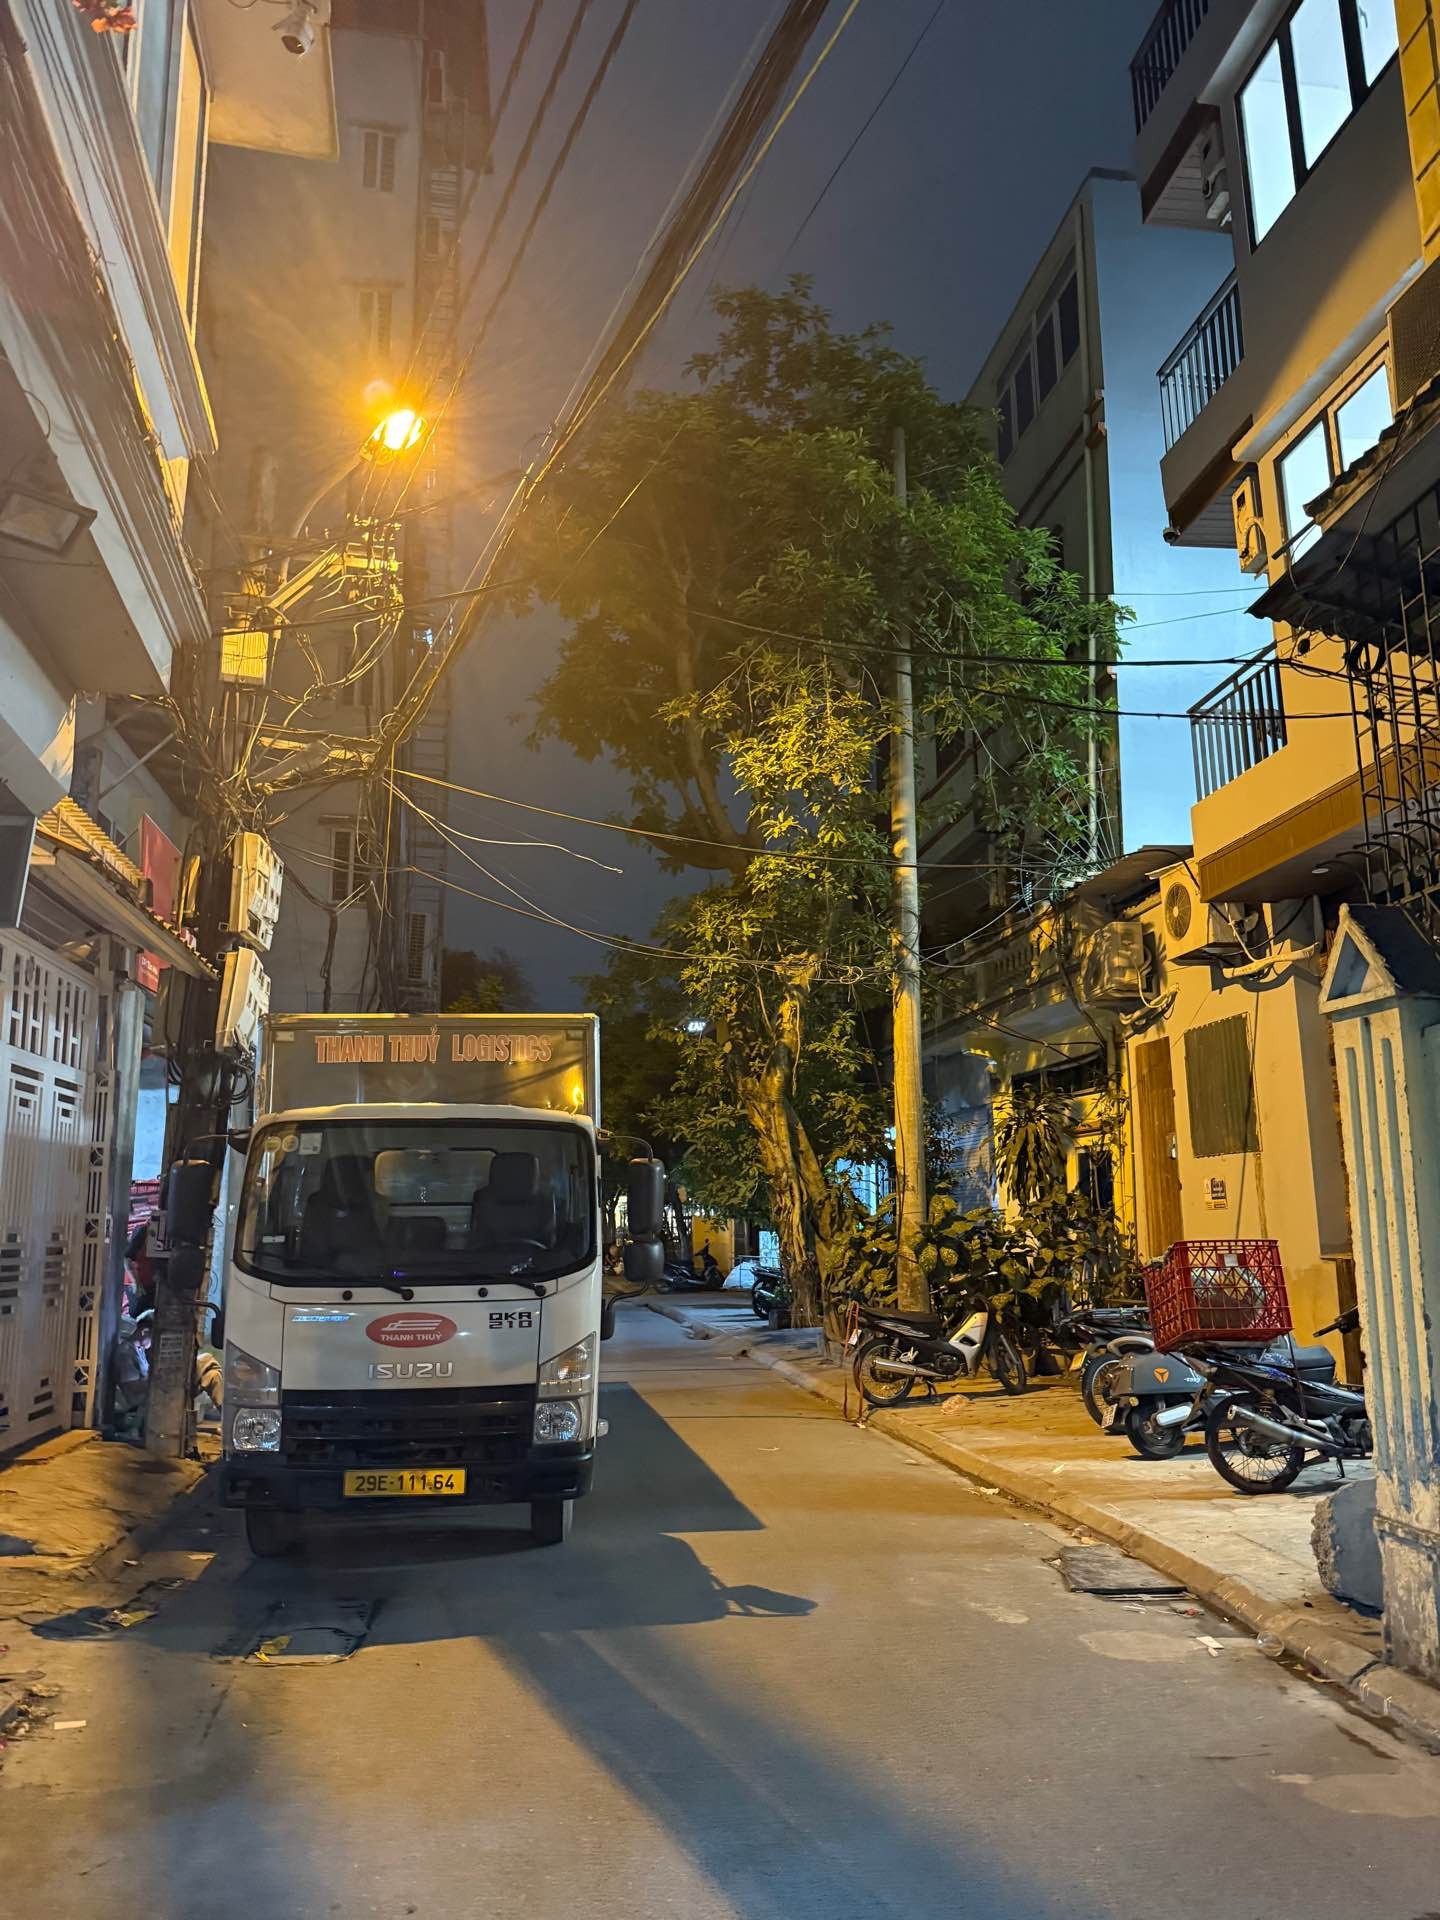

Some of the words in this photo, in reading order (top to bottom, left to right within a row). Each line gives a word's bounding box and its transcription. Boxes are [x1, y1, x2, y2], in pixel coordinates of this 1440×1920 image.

[315, 1035, 384, 1063] THANH
[452, 1034, 552, 1062] LOGISTICS
[489, 1312, 532, 1320] QKR
[489, 1320, 533, 1329] 210
[368, 1362, 454, 1379] ISUZU
[355, 1474, 455, 1491] 29E-111.64
